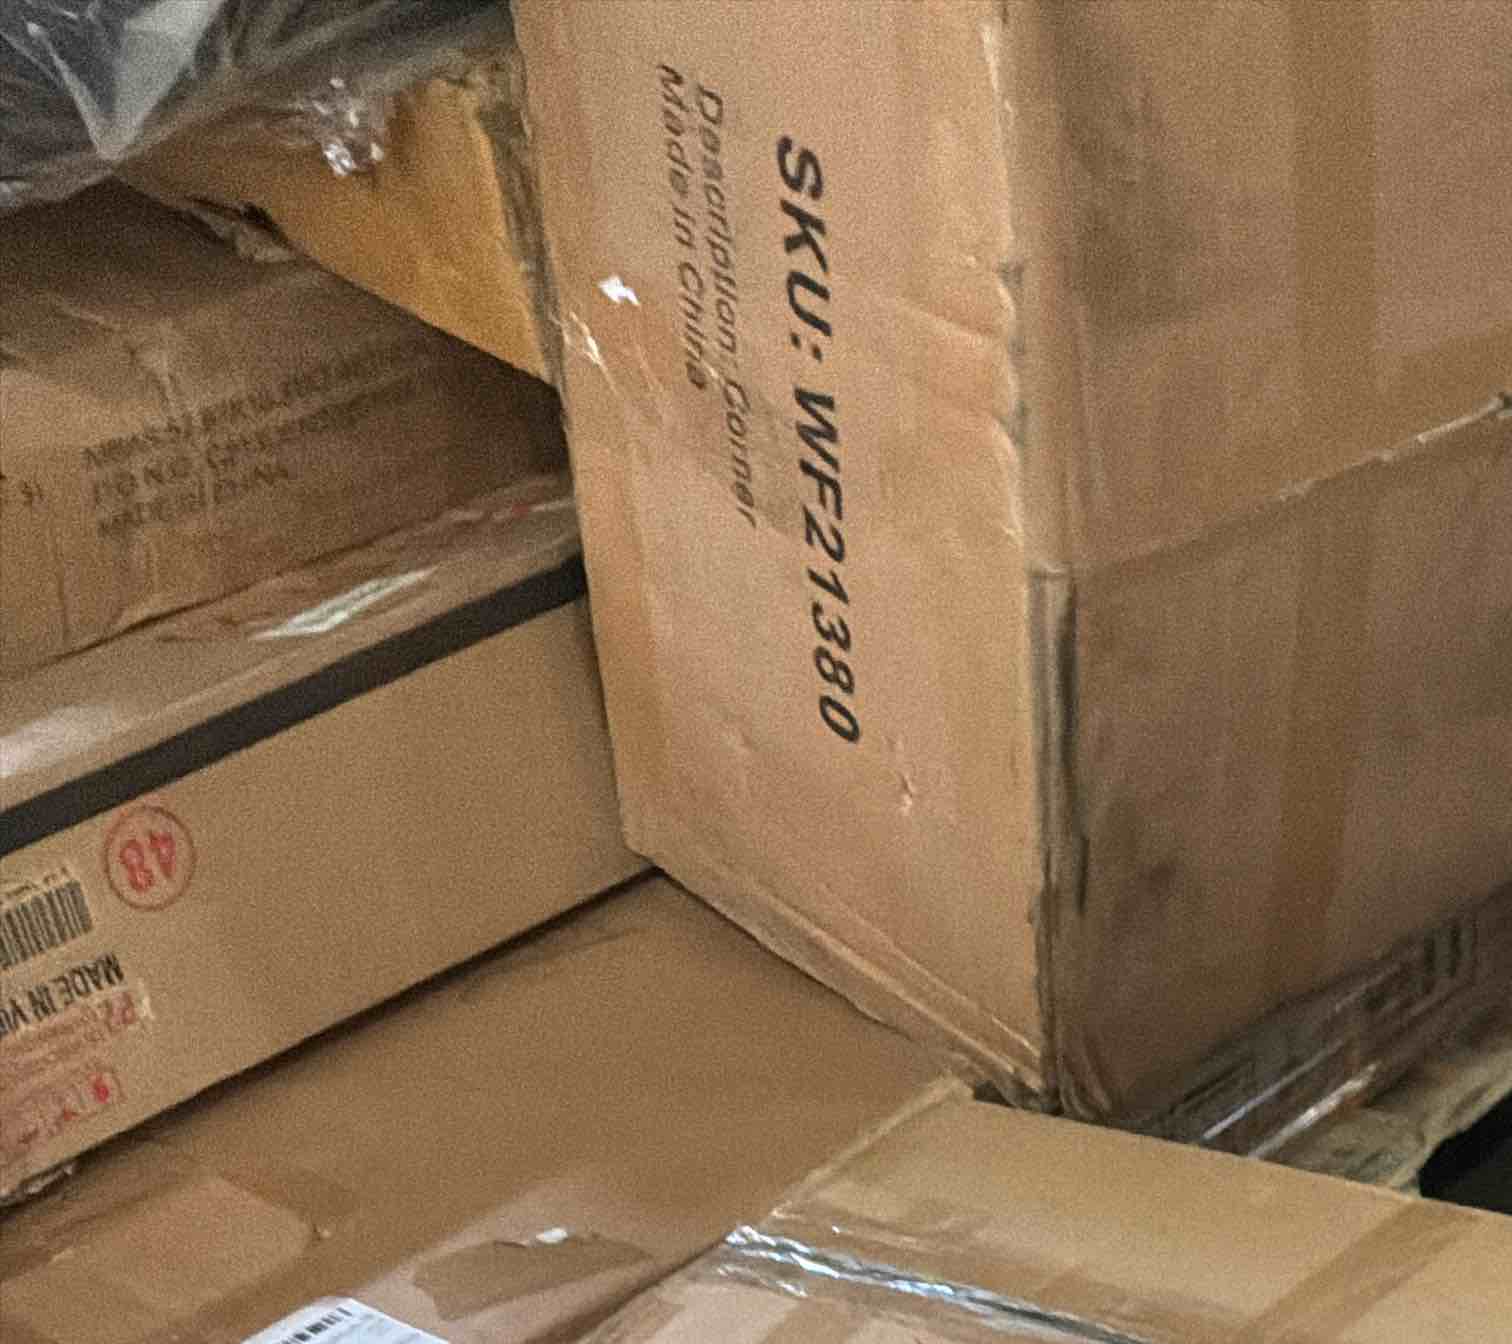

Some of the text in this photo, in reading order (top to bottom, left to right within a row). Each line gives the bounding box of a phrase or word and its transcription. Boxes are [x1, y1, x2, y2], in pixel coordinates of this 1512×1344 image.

[657, 62, 690, 194] Made
[676, 260, 705, 391] China
[719, 380, 757, 530] Corner
[776, 135, 864, 746] SKU: WF21380
[27, 984, 58, 1022] IN
[49, 954, 125, 1007] MADE
